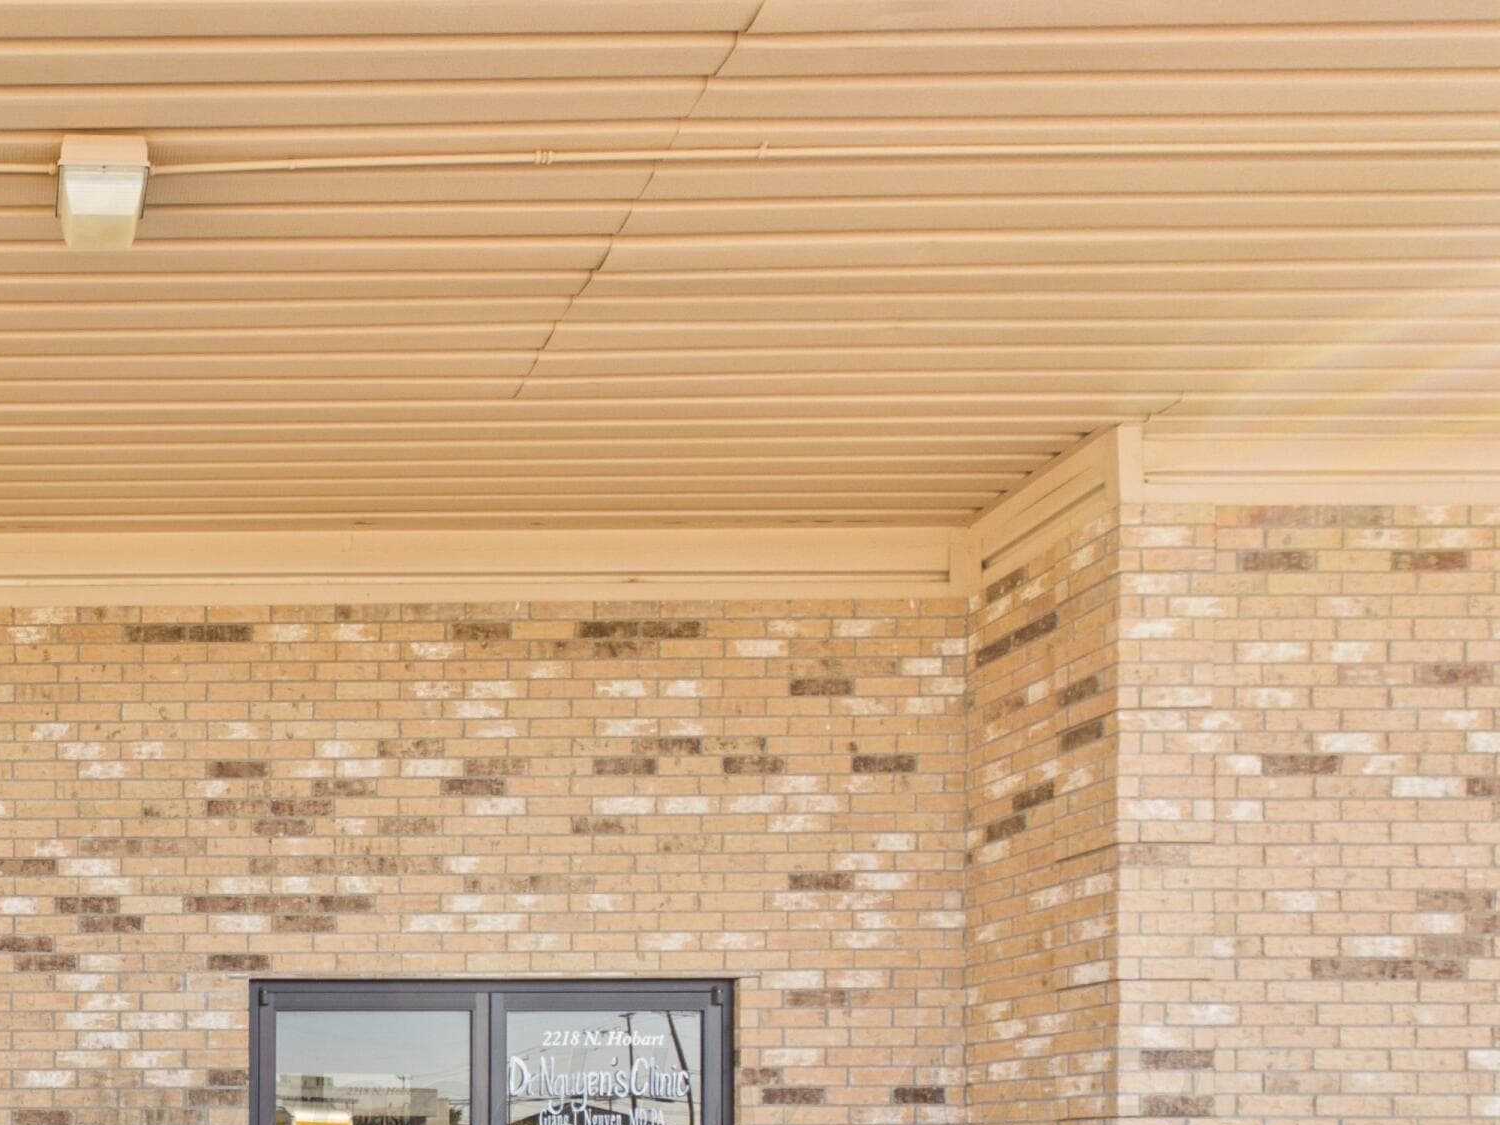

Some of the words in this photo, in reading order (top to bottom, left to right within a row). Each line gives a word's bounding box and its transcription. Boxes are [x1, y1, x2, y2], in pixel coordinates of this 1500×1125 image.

[542, 1031, 580, 1046] 2218
[583, 1031, 601, 1046] N.
[607, 1031, 665, 1046] Hobart
[540, 1055, 629, 1115] Nguyen's
[631, 1057, 690, 1097] Clinic
